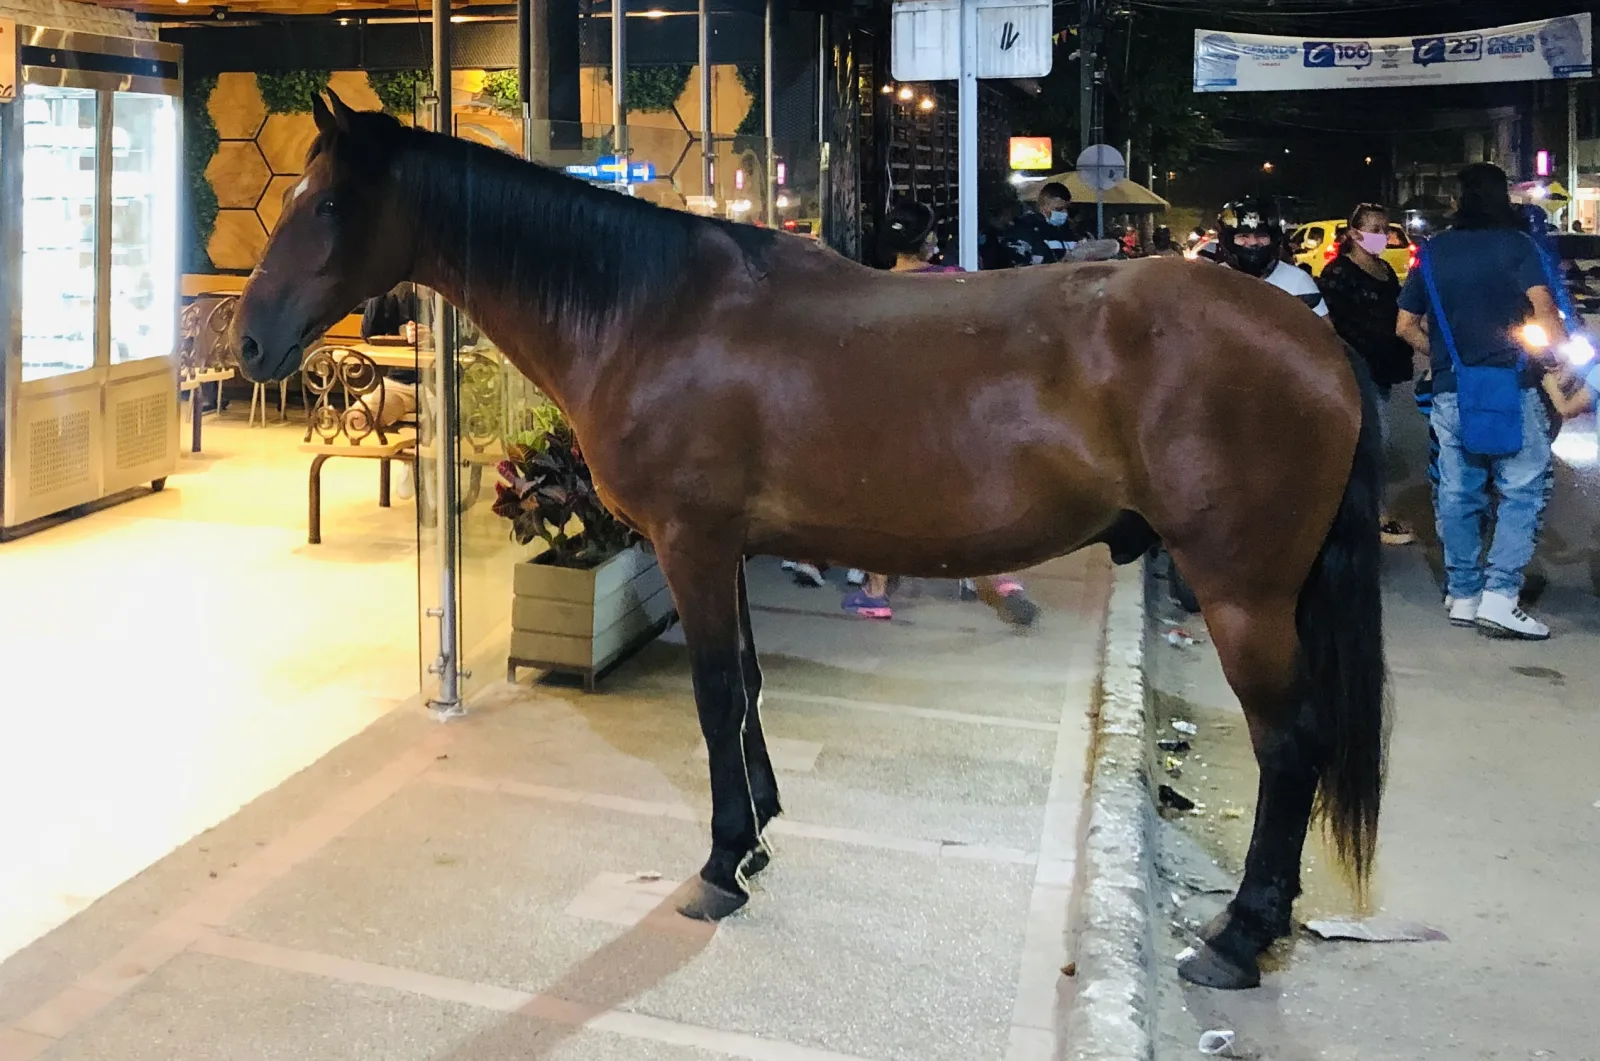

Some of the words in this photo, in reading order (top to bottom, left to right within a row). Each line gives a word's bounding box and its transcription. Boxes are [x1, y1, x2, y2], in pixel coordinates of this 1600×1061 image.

[1336, 44, 1370, 60] 106
[1449, 36, 1478, 54] 25
[1487, 44, 1535, 55] BARRETO
